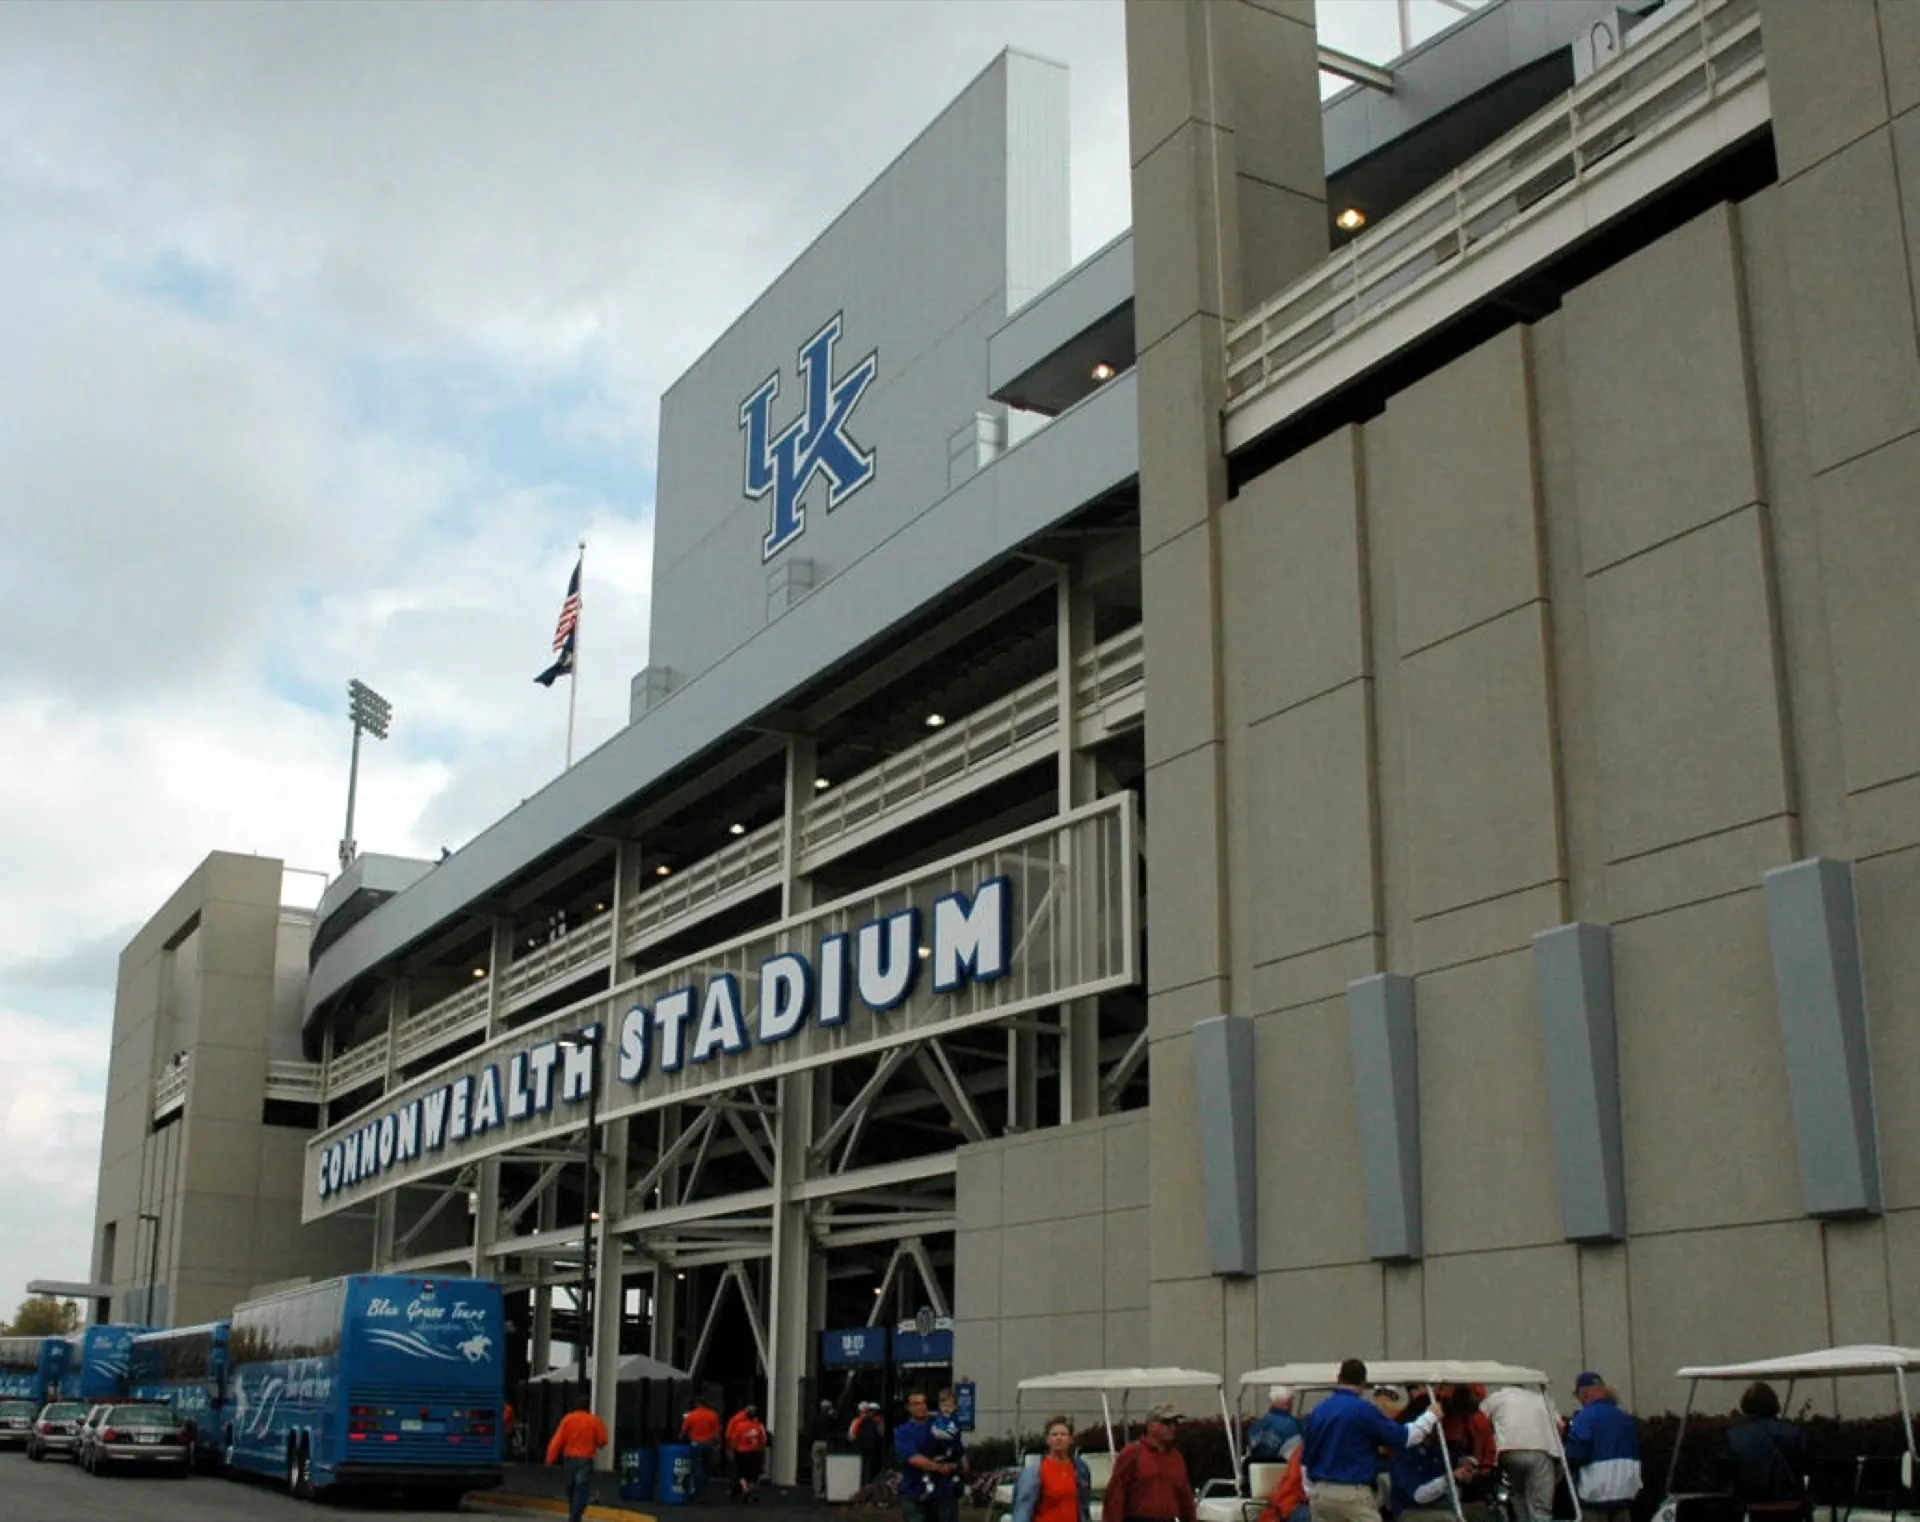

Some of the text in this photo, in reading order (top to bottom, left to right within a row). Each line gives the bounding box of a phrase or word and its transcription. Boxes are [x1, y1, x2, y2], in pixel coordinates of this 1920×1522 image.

[738, 308, 878, 565] UK
[318, 874, 1011, 1198] COMMONWEALTH STADIUM
[451, 1300, 486, 1320] Tours
